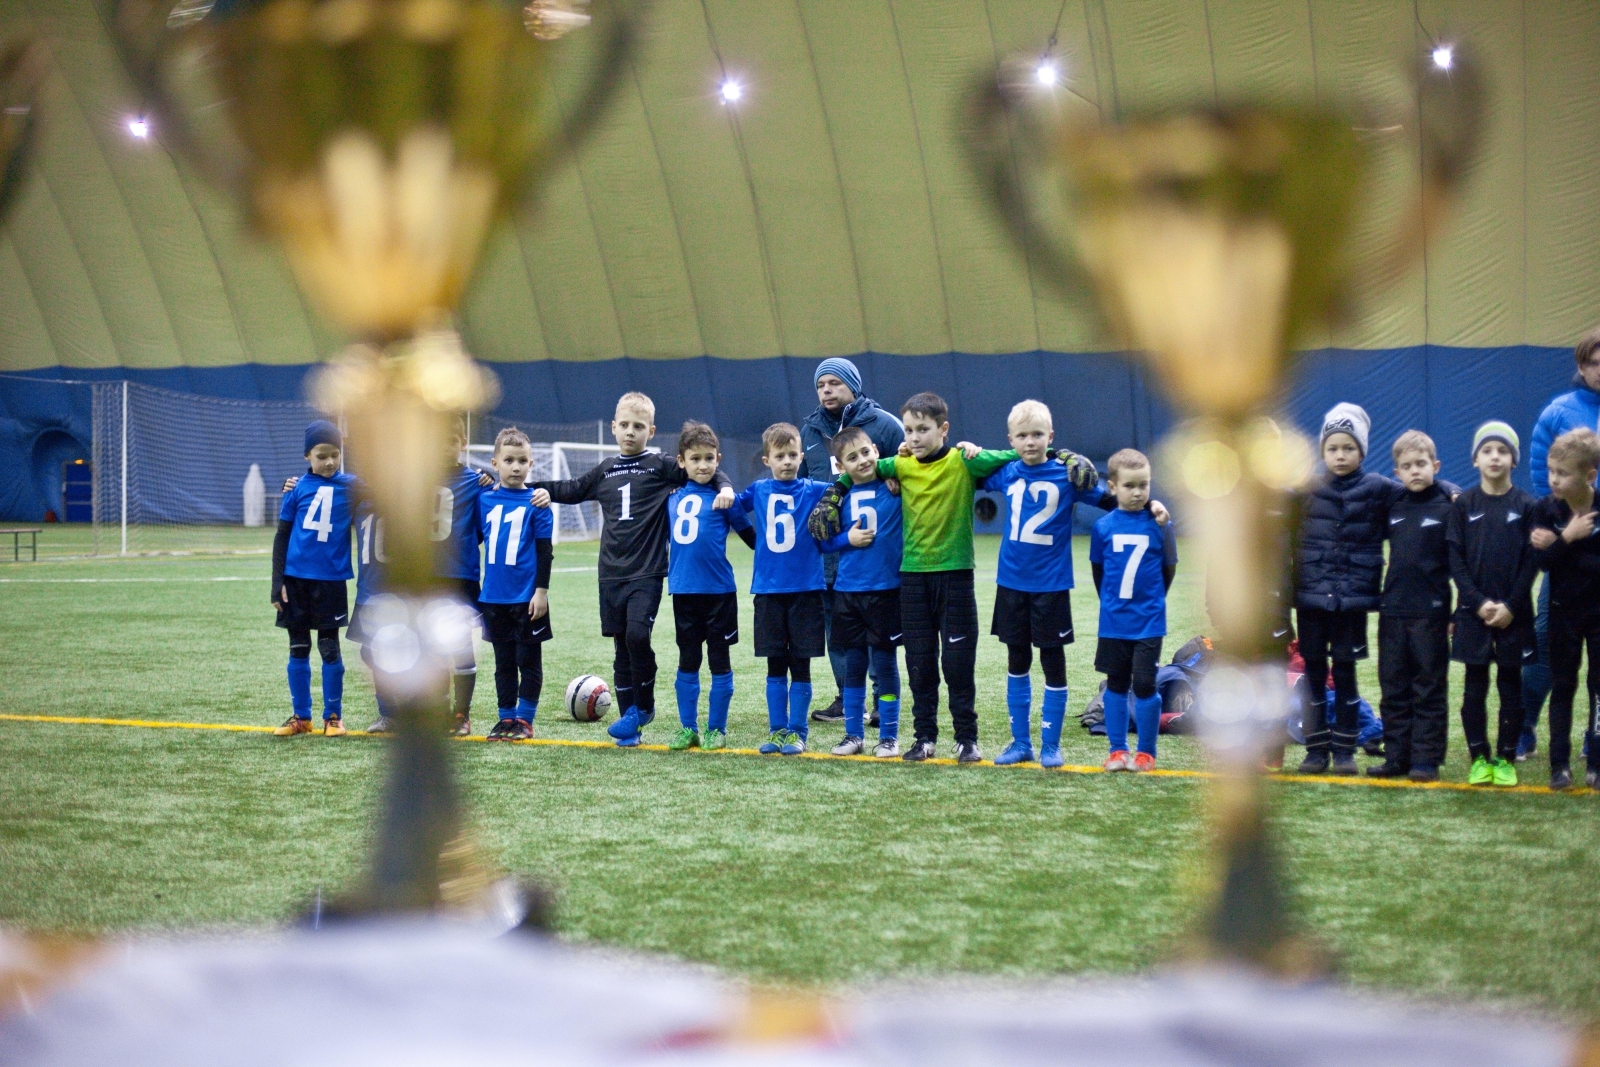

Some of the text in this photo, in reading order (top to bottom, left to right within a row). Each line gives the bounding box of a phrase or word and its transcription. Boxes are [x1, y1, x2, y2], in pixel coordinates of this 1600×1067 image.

[303, 485, 334, 542] 4
[617, 482, 634, 521] 1
[673, 494, 702, 545] 8
[766, 493, 796, 553] 6
[850, 490, 878, 535] 5
[1006, 478, 1060, 546] 12
[486, 504, 527, 566] 11
[1112, 534, 1150, 600] 7
